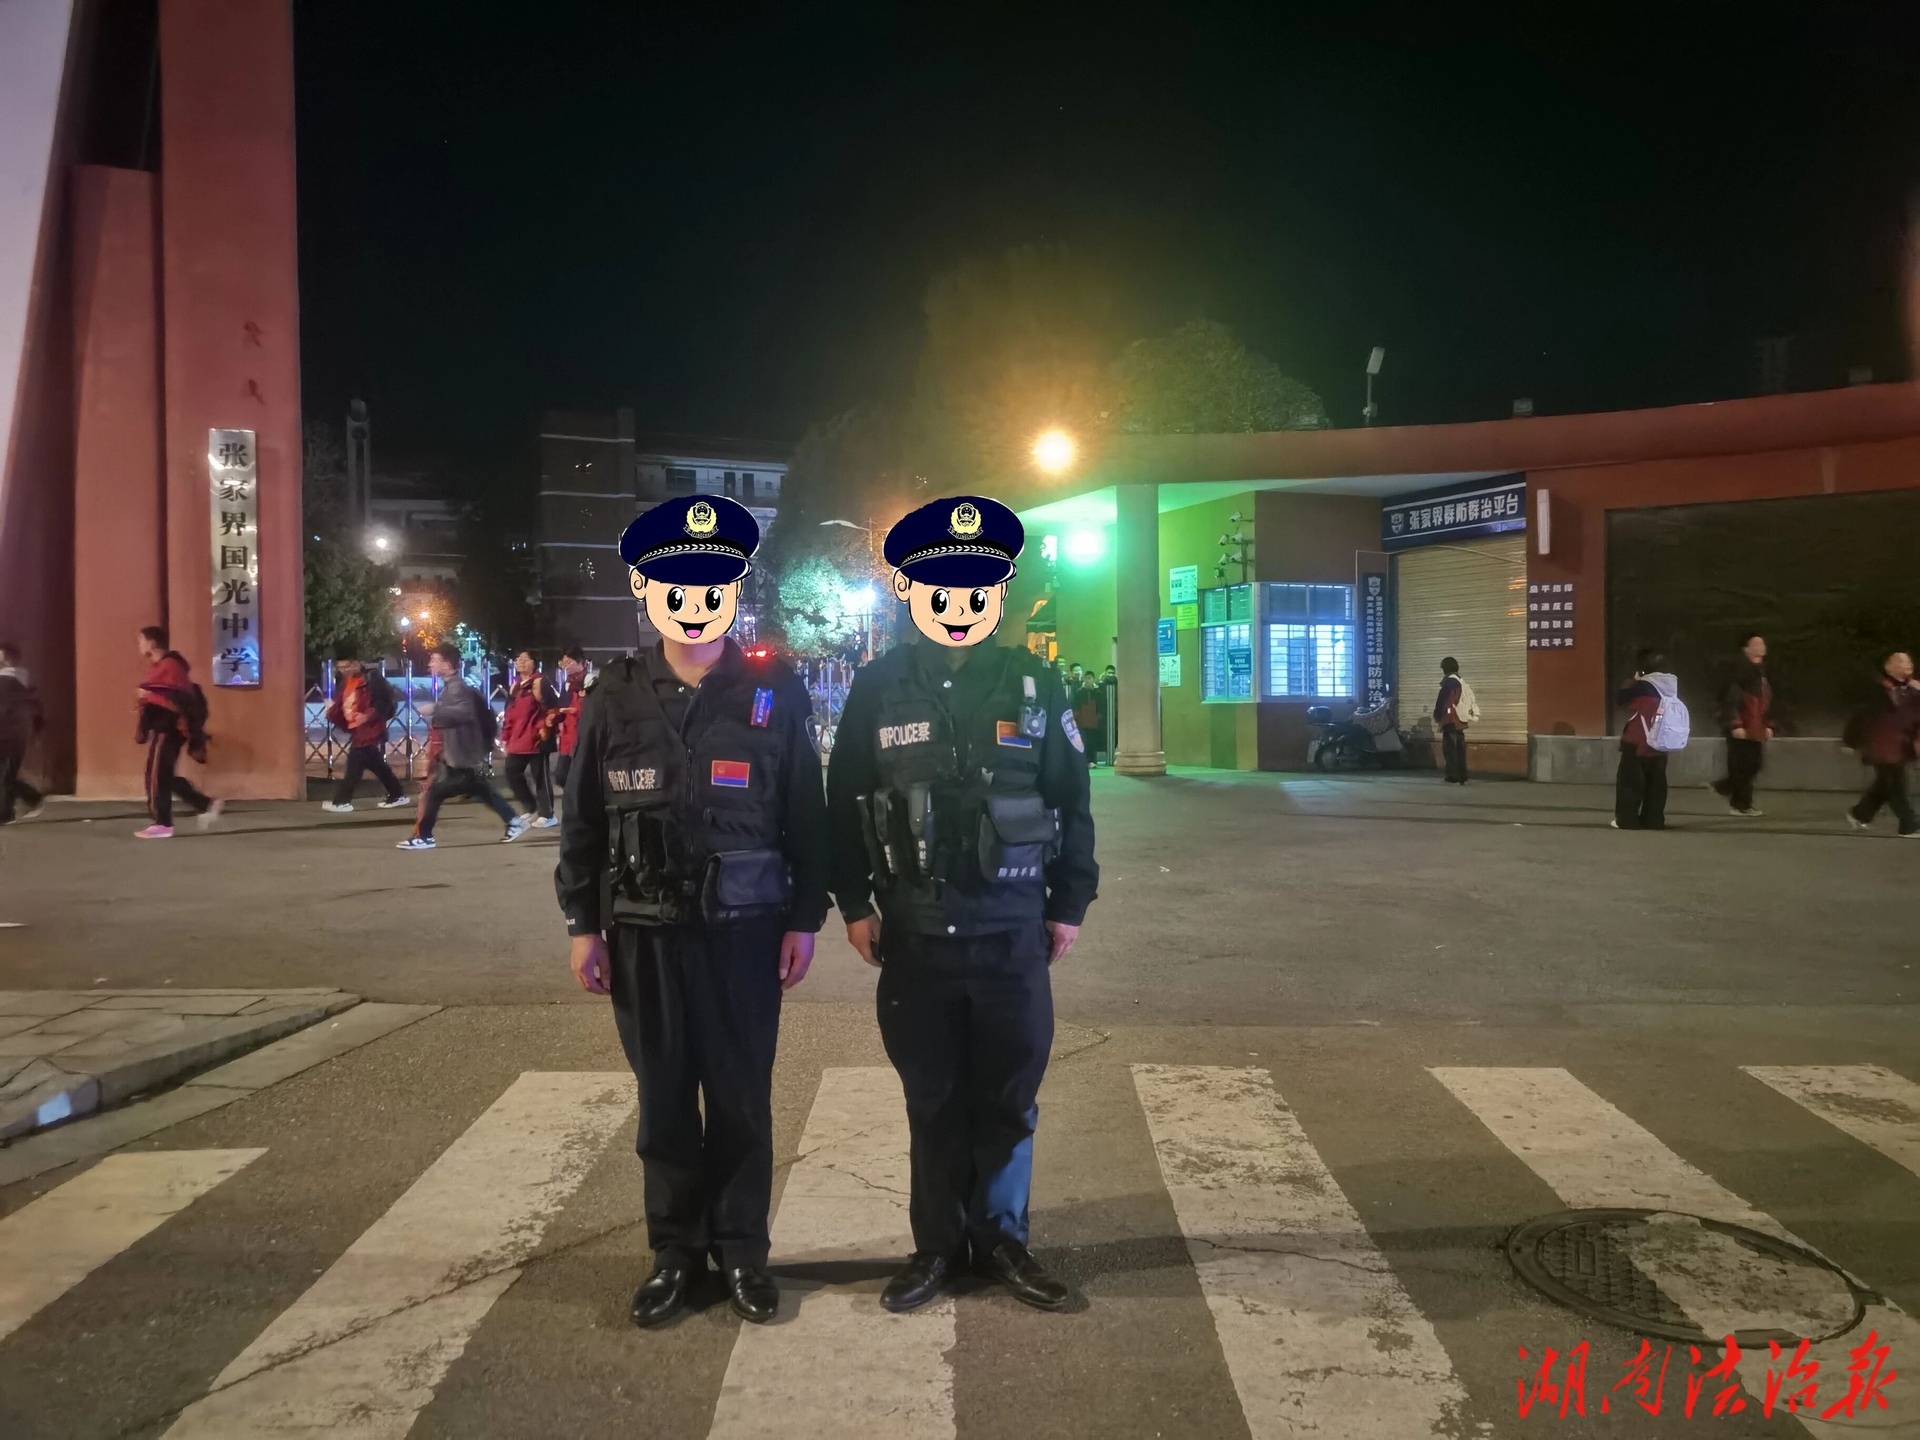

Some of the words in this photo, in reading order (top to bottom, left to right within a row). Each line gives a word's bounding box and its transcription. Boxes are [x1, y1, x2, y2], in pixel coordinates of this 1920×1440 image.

[1409, 493, 1519, 531] 张家界群防群治平台
[218, 442, 251, 673] 张家界国光中学
[1367, 654, 1383, 702] 群防群治
